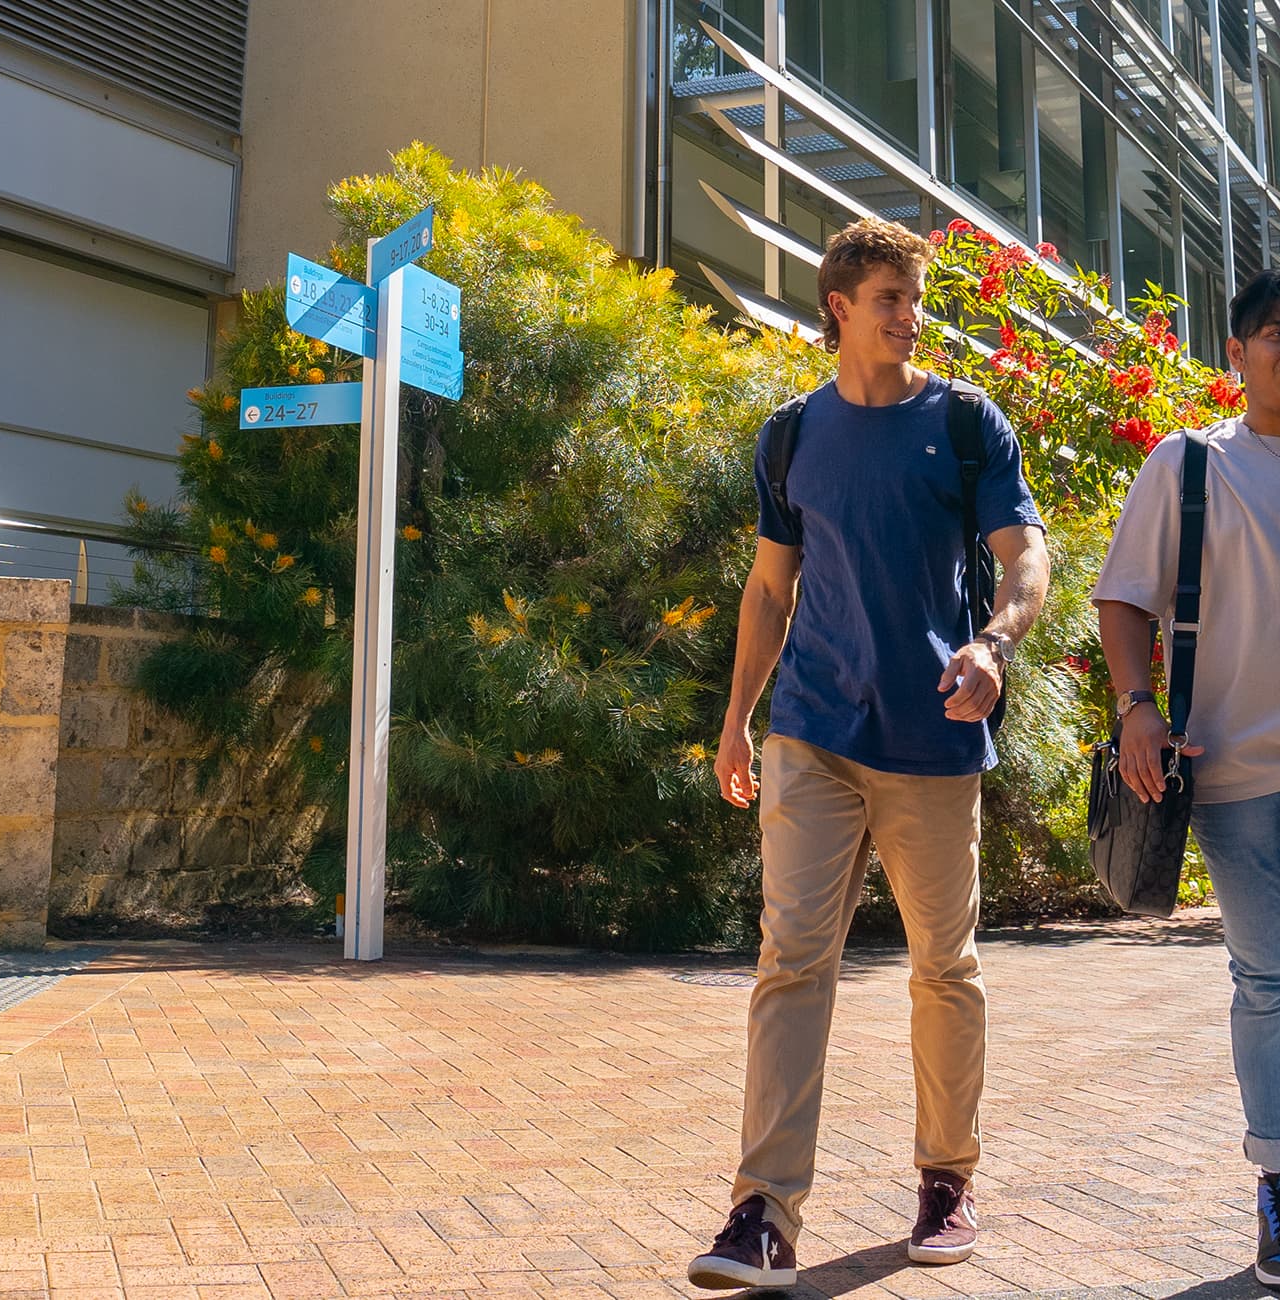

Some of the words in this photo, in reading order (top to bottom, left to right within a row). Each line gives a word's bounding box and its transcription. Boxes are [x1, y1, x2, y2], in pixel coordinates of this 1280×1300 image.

[424, 312, 449, 338] 30-34
[264, 391, 296, 401] Buildings
[264, 401, 319, 422] 24-27
